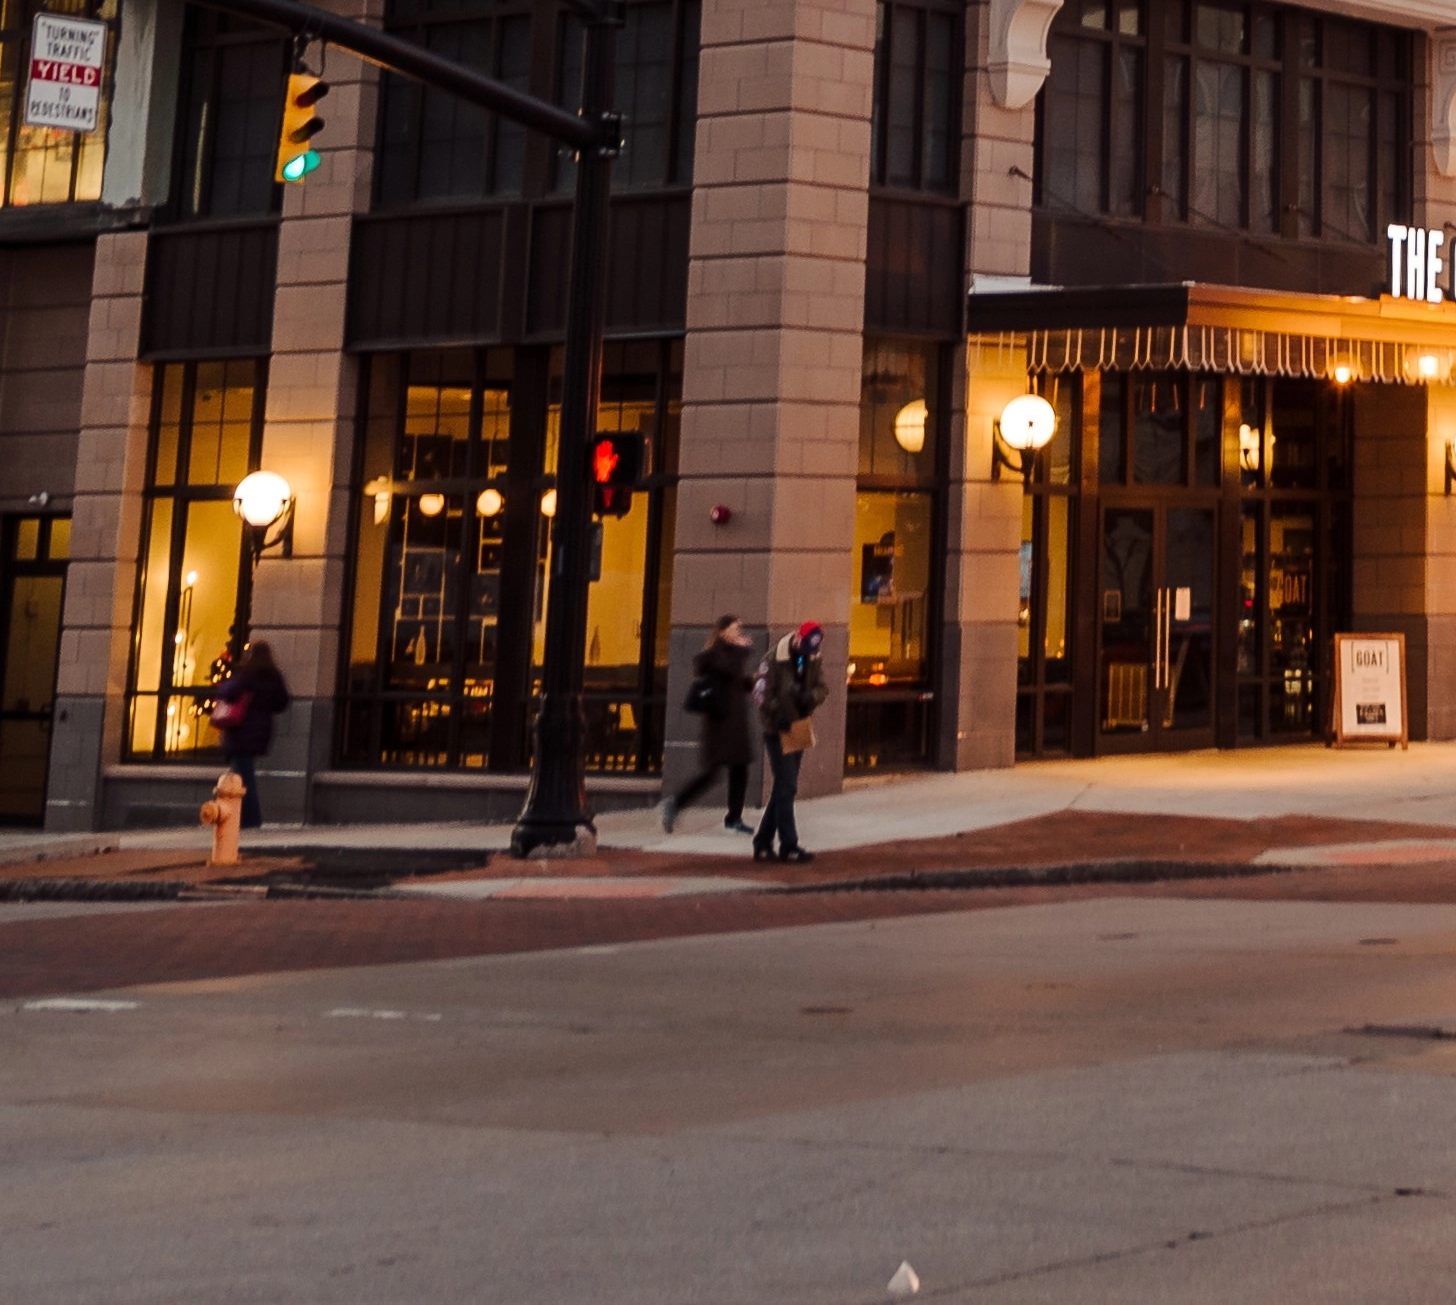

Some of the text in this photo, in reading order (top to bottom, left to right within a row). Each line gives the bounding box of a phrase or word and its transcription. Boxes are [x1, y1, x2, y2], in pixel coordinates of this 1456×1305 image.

[47, 42, 92, 62] TRAFFIC
[39, 60, 96, 85] YIELD
[1388, 224, 1444, 303] THE
[1356, 651, 1383, 666] GOAT
